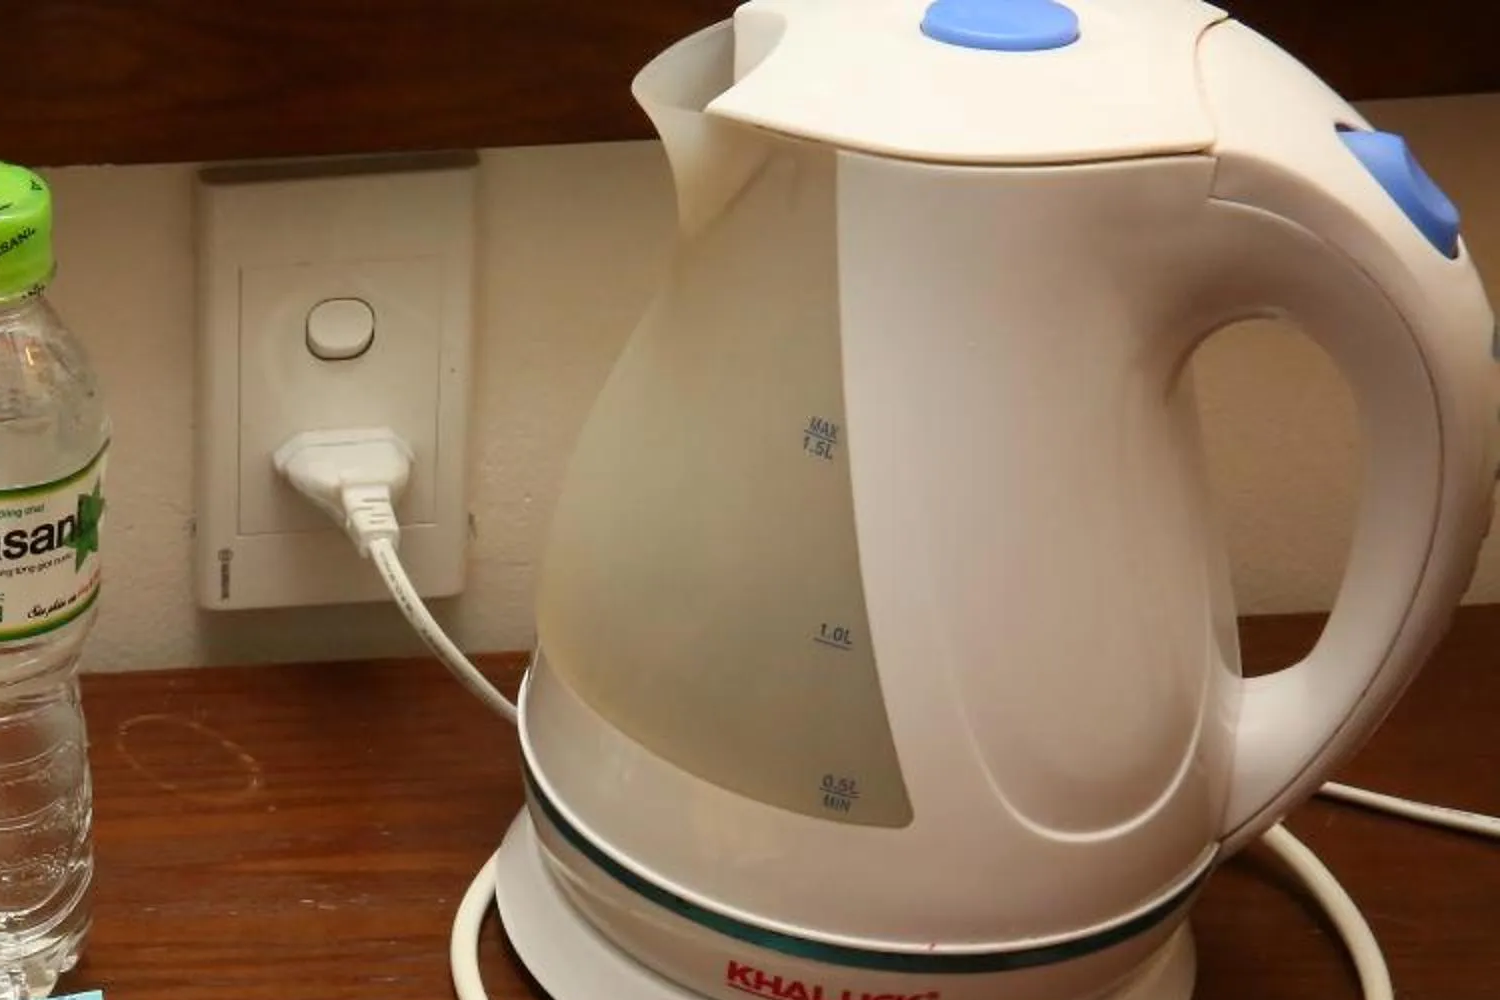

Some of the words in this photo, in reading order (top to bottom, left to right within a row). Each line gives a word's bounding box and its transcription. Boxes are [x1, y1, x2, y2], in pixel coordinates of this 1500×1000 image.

[809, 416, 838, 439] MAX
[820, 623, 853, 646] 1.0L
[822, 773, 860, 795] 0.5L
